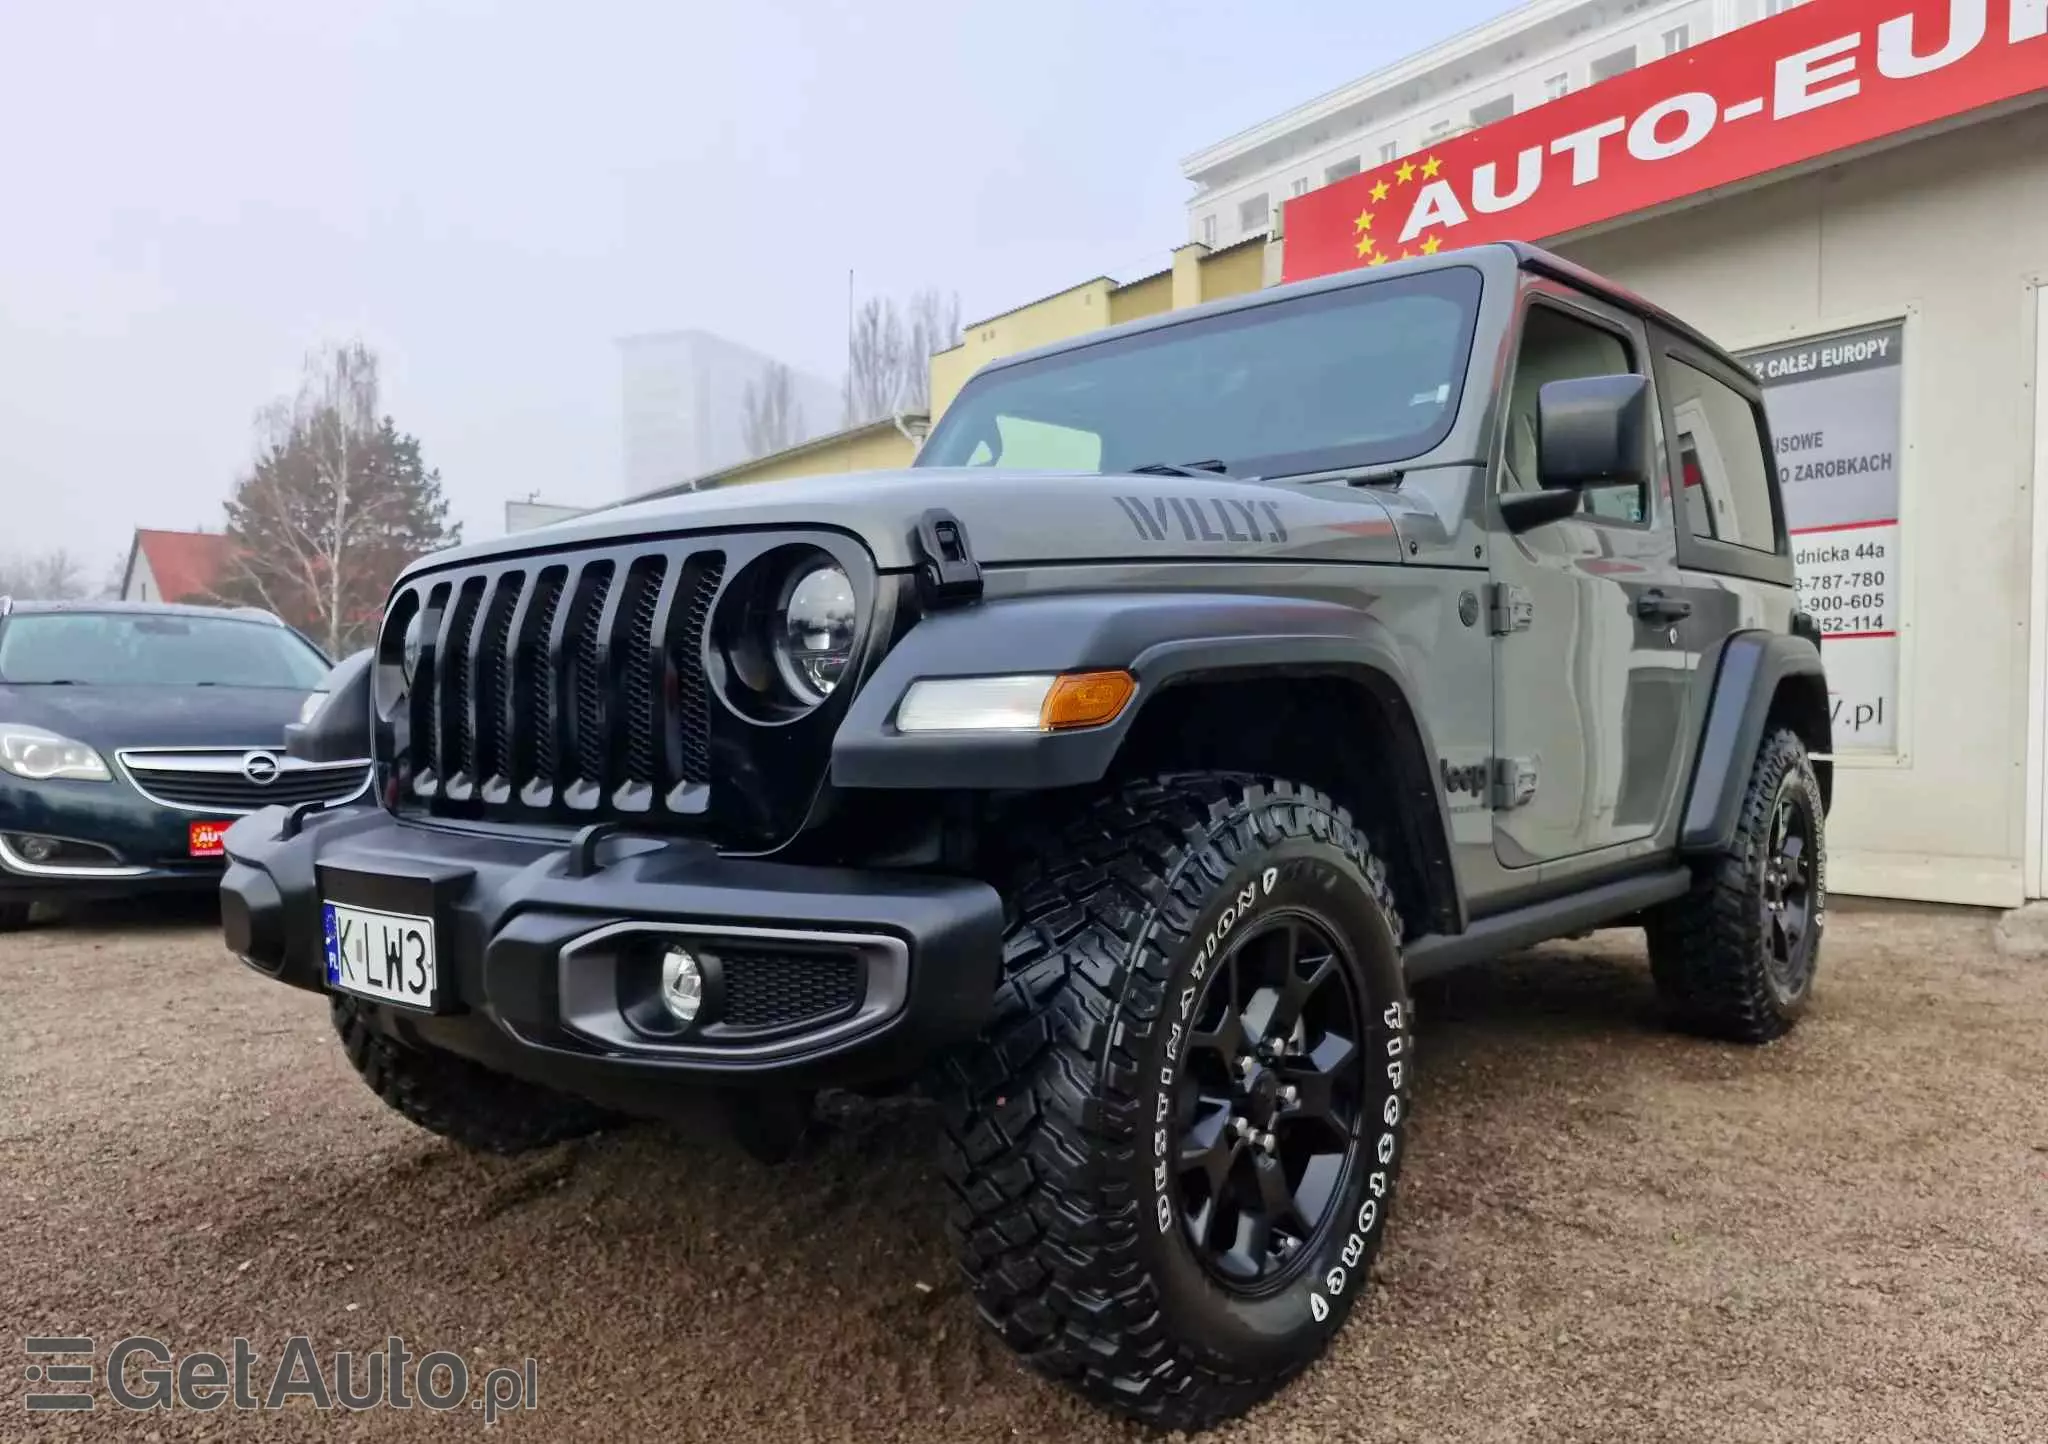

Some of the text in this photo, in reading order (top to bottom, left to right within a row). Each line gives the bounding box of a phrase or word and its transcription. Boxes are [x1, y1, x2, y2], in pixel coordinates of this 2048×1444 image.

[1767, 351, 1817, 379] CAŁEJ
[1820, 337, 1890, 368] EUROPY
[1794, 452, 1892, 482] ZAROBKACH
[1112, 496, 1288, 543] WILLYS
[1855, 541, 1885, 560] 44a
[1799, 592, 1884, 612] -900-605
